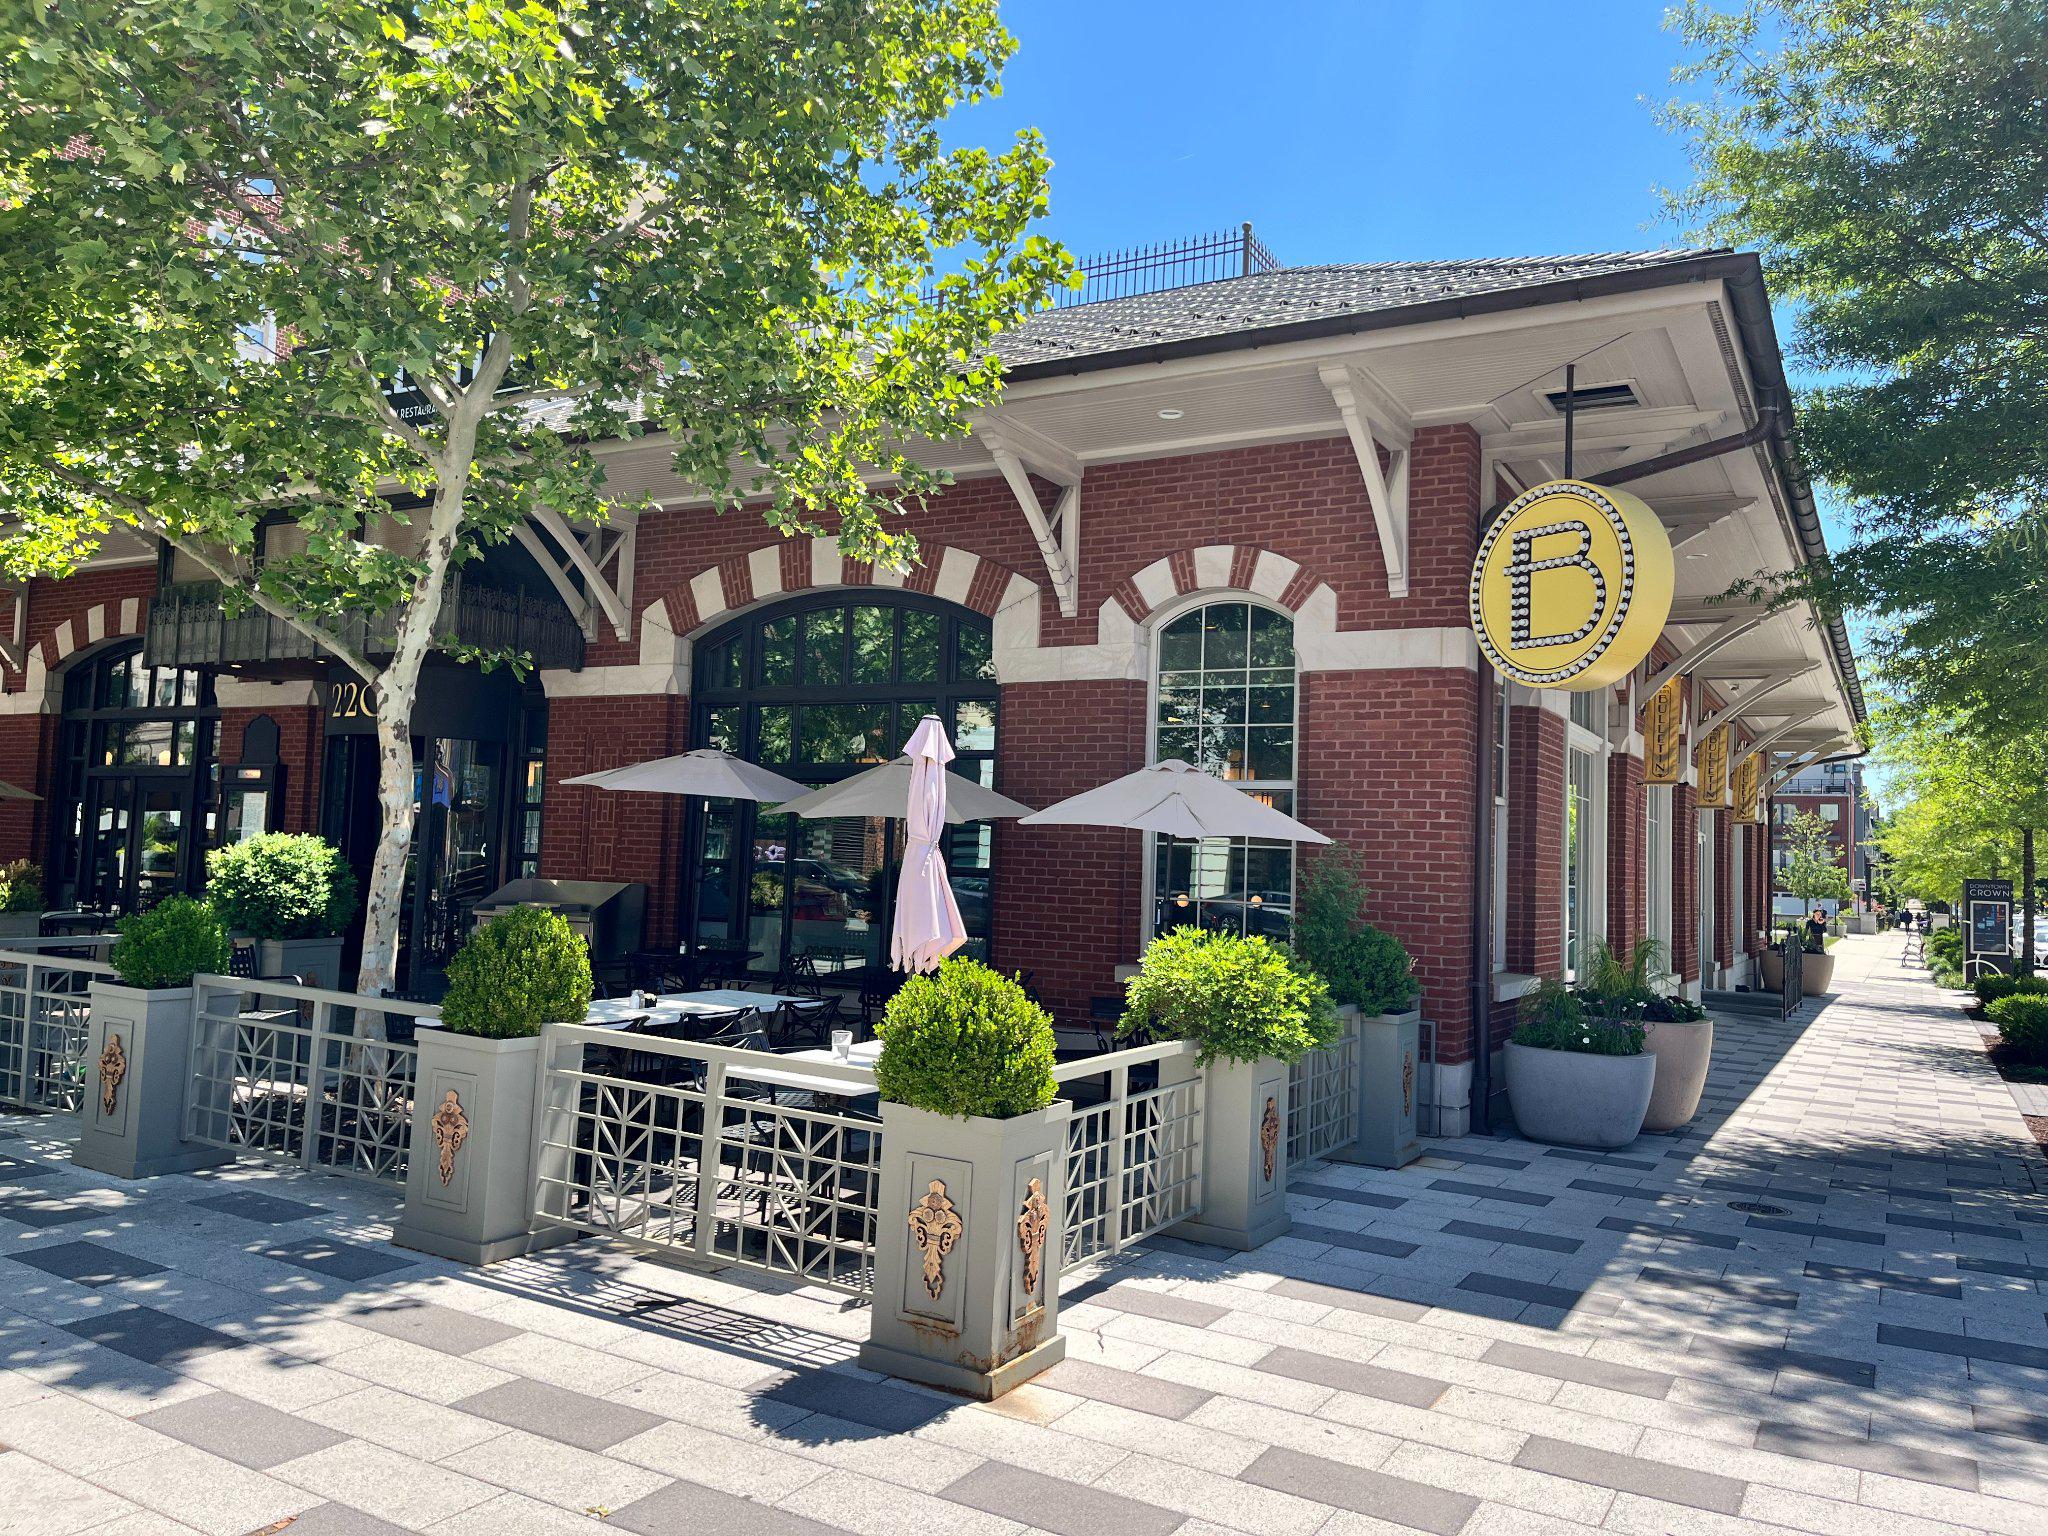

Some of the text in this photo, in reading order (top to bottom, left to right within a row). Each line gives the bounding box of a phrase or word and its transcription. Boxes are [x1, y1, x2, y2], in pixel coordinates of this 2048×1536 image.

[400, 404, 438, 418] RESTAURA
[1503, 520, 1607, 651] B
[1655, 694, 1668, 772] BULLETIN
[1969, 889, 2010, 898] CROWN
